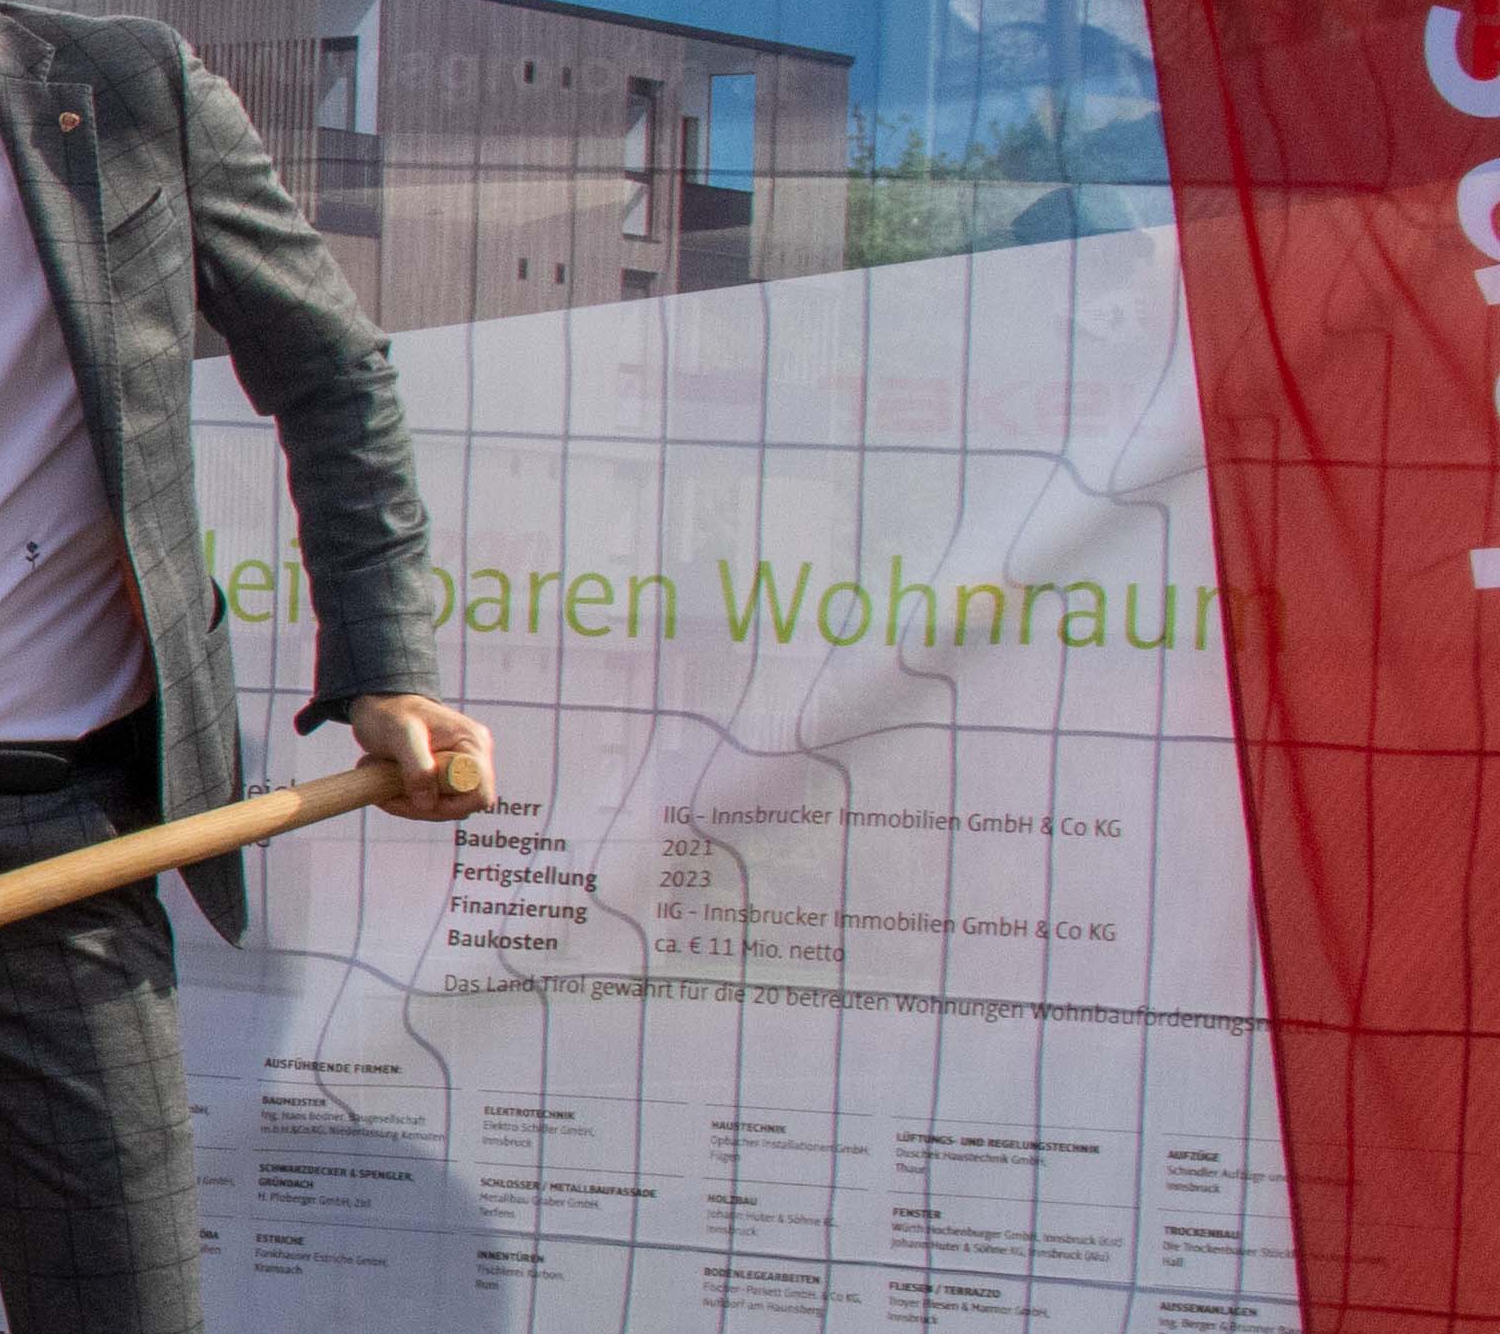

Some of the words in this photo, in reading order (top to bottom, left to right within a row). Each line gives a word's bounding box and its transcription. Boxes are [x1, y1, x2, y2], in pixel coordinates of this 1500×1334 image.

[663, 805, 691, 823] IIG
[711, 805, 833, 826] Innsbrucker
[839, 806, 962, 832] Immobilien
[967, 813, 1033, 835] GmbH
[1040, 815, 1055, 835] &
[1060, 817, 1087, 837] Co
[1094, 818, 1122, 838] KG
[454, 829, 566, 855] Baubeginn
[662, 839, 713, 857] 2021
[453, 862, 598, 892] Fertigstellung
[660, 870, 712, 888] 2023
[450, 895, 588, 924] Finanzierung
[656, 902, 683, 919] IIG
[703, 903, 828, 927] Innsbrucker
[834, 909, 956, 935] Immobilien
[962, 915, 1028, 938] GmbH
[1034, 918, 1049, 939] &
[1055, 921, 1082, 940] Co
[1088, 922, 1117, 942] KG
[447, 929, 558, 951] Baukosten
[655, 939, 682, 953] ca.
[688, 937, 702, 954] €
[711, 938, 733, 955] 11
[742, 940, 783, 960] Mio.
[790, 944, 845, 963] netto
[444, 974, 480, 993] Das
[486, 975, 536, 993] Land
[540, 975, 585, 994] Tirol
[591, 978, 674, 1001] gewährt
[679, 980, 709, 1000] für
[714, 983, 746, 1003] die
[753, 985, 779, 1005] 20
[785, 986, 890, 1013] betreuten
[895, 991, 1025, 1022] Wohnungen
[264, 1056, 351, 1073] AUSFÜHRENDE
[960, 1137, 986, 1147] UND
